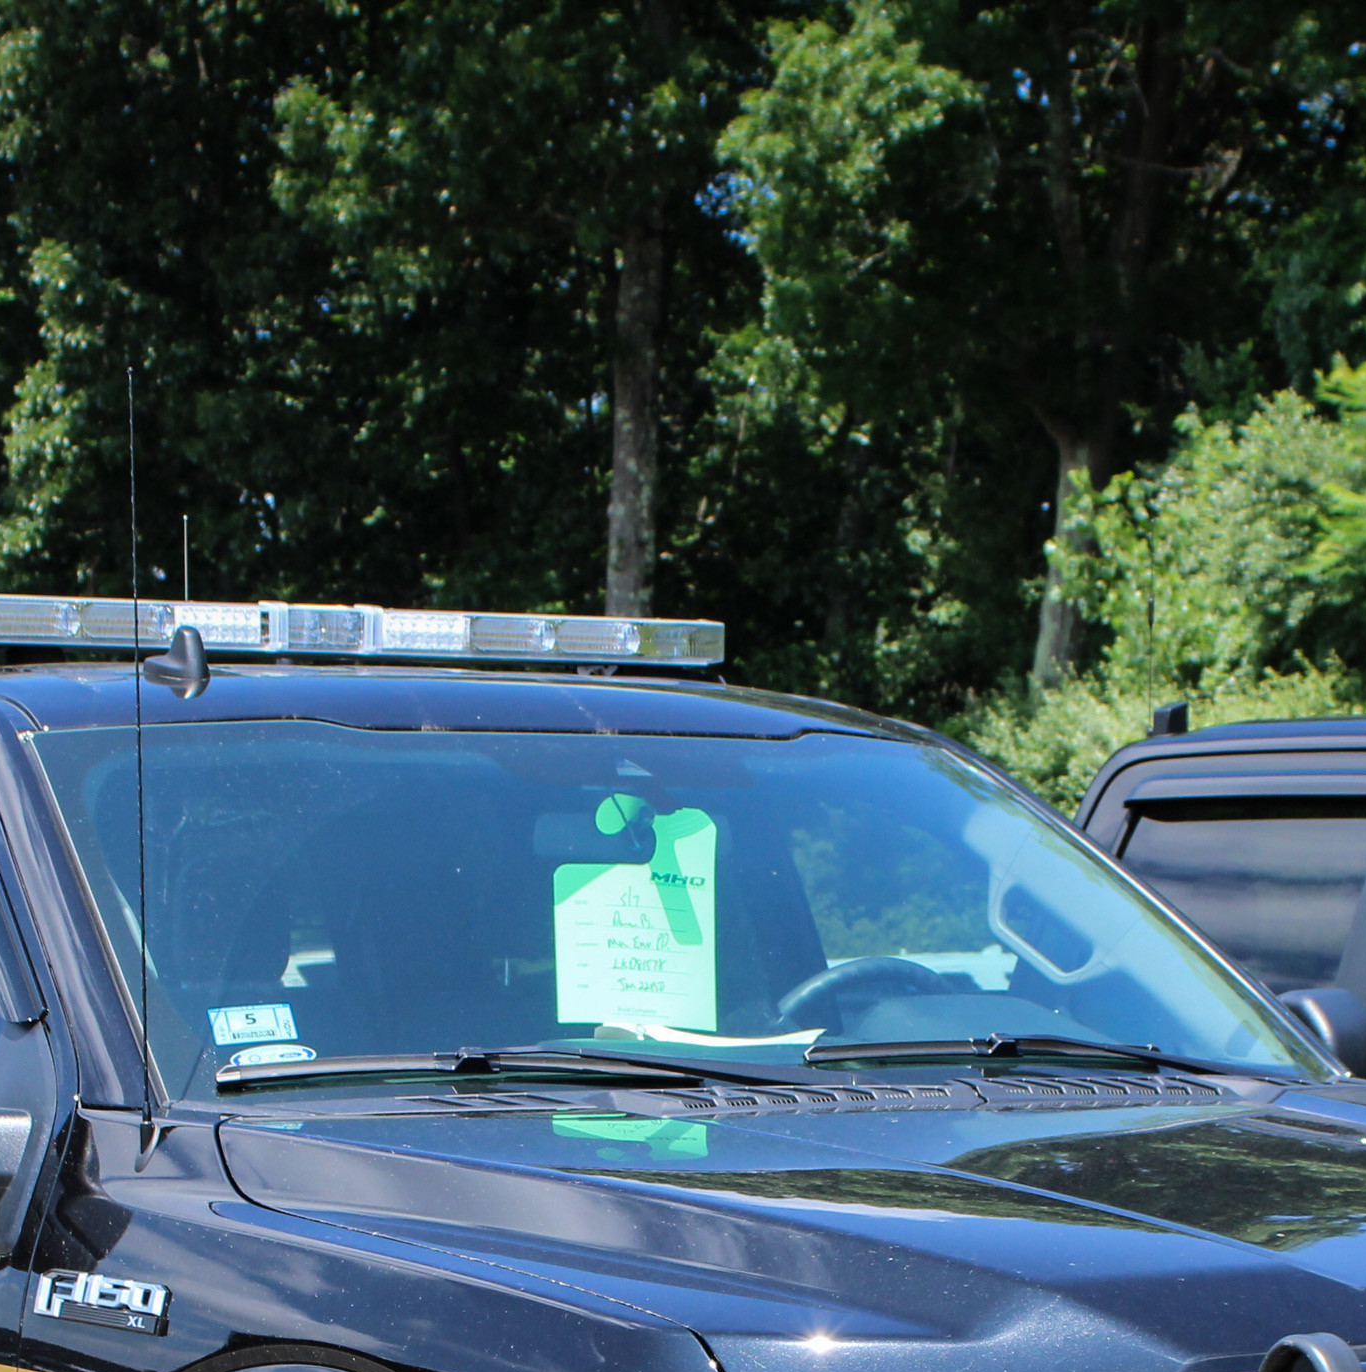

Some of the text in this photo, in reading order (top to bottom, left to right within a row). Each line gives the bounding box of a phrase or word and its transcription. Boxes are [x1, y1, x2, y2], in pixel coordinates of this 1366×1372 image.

[652, 871, 705, 887] MHQ
[245, 1013, 257, 1025] 5
[127, 1315, 146, 1329] XL
